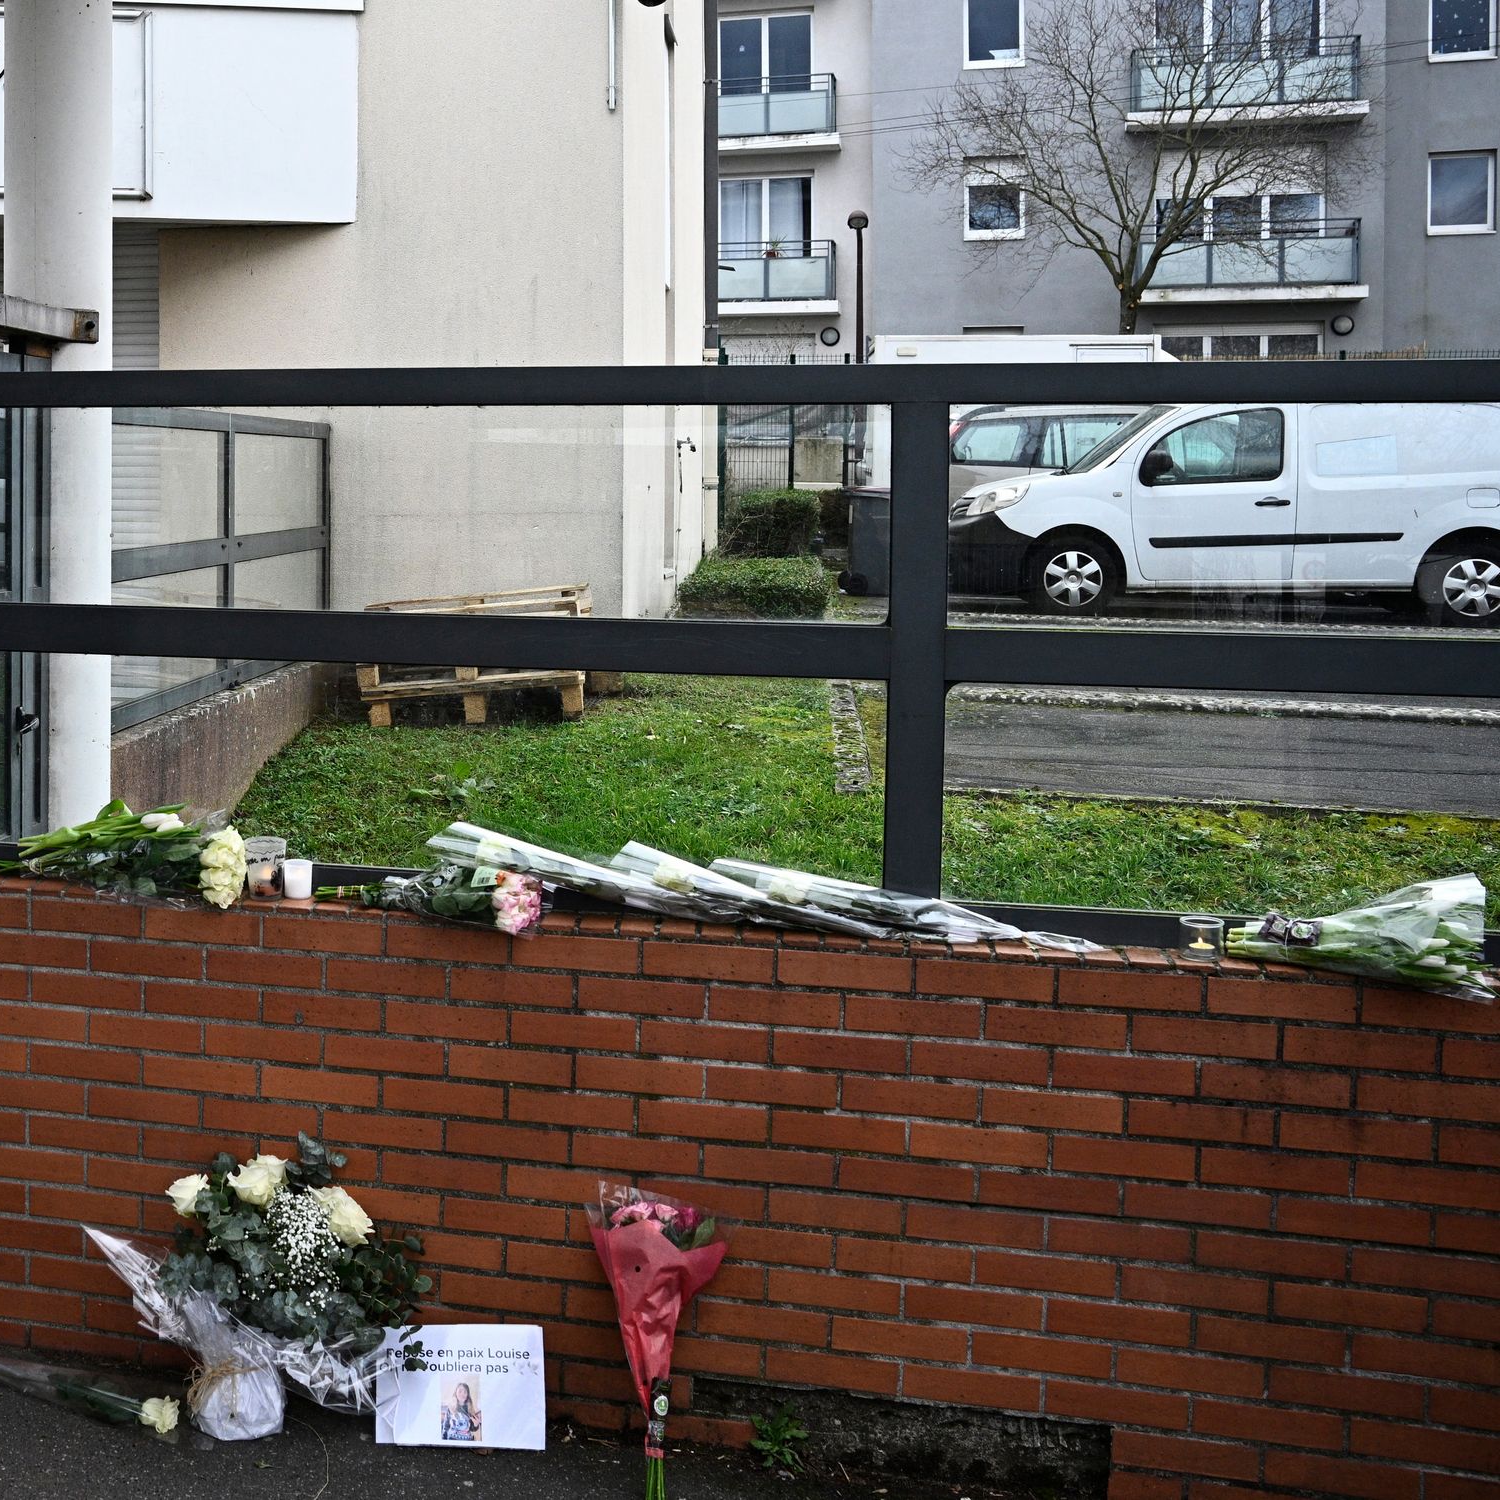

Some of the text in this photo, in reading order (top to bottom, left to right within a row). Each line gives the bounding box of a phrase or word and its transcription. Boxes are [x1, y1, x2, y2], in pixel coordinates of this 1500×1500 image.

[438, 1349, 453, 1358] en
[457, 1348, 484, 1361] paix
[488, 1347, 530, 1360] Louise
[425, 1361, 482, 1372] 'oubliera
[486, 1364, 509, 1375] pas
